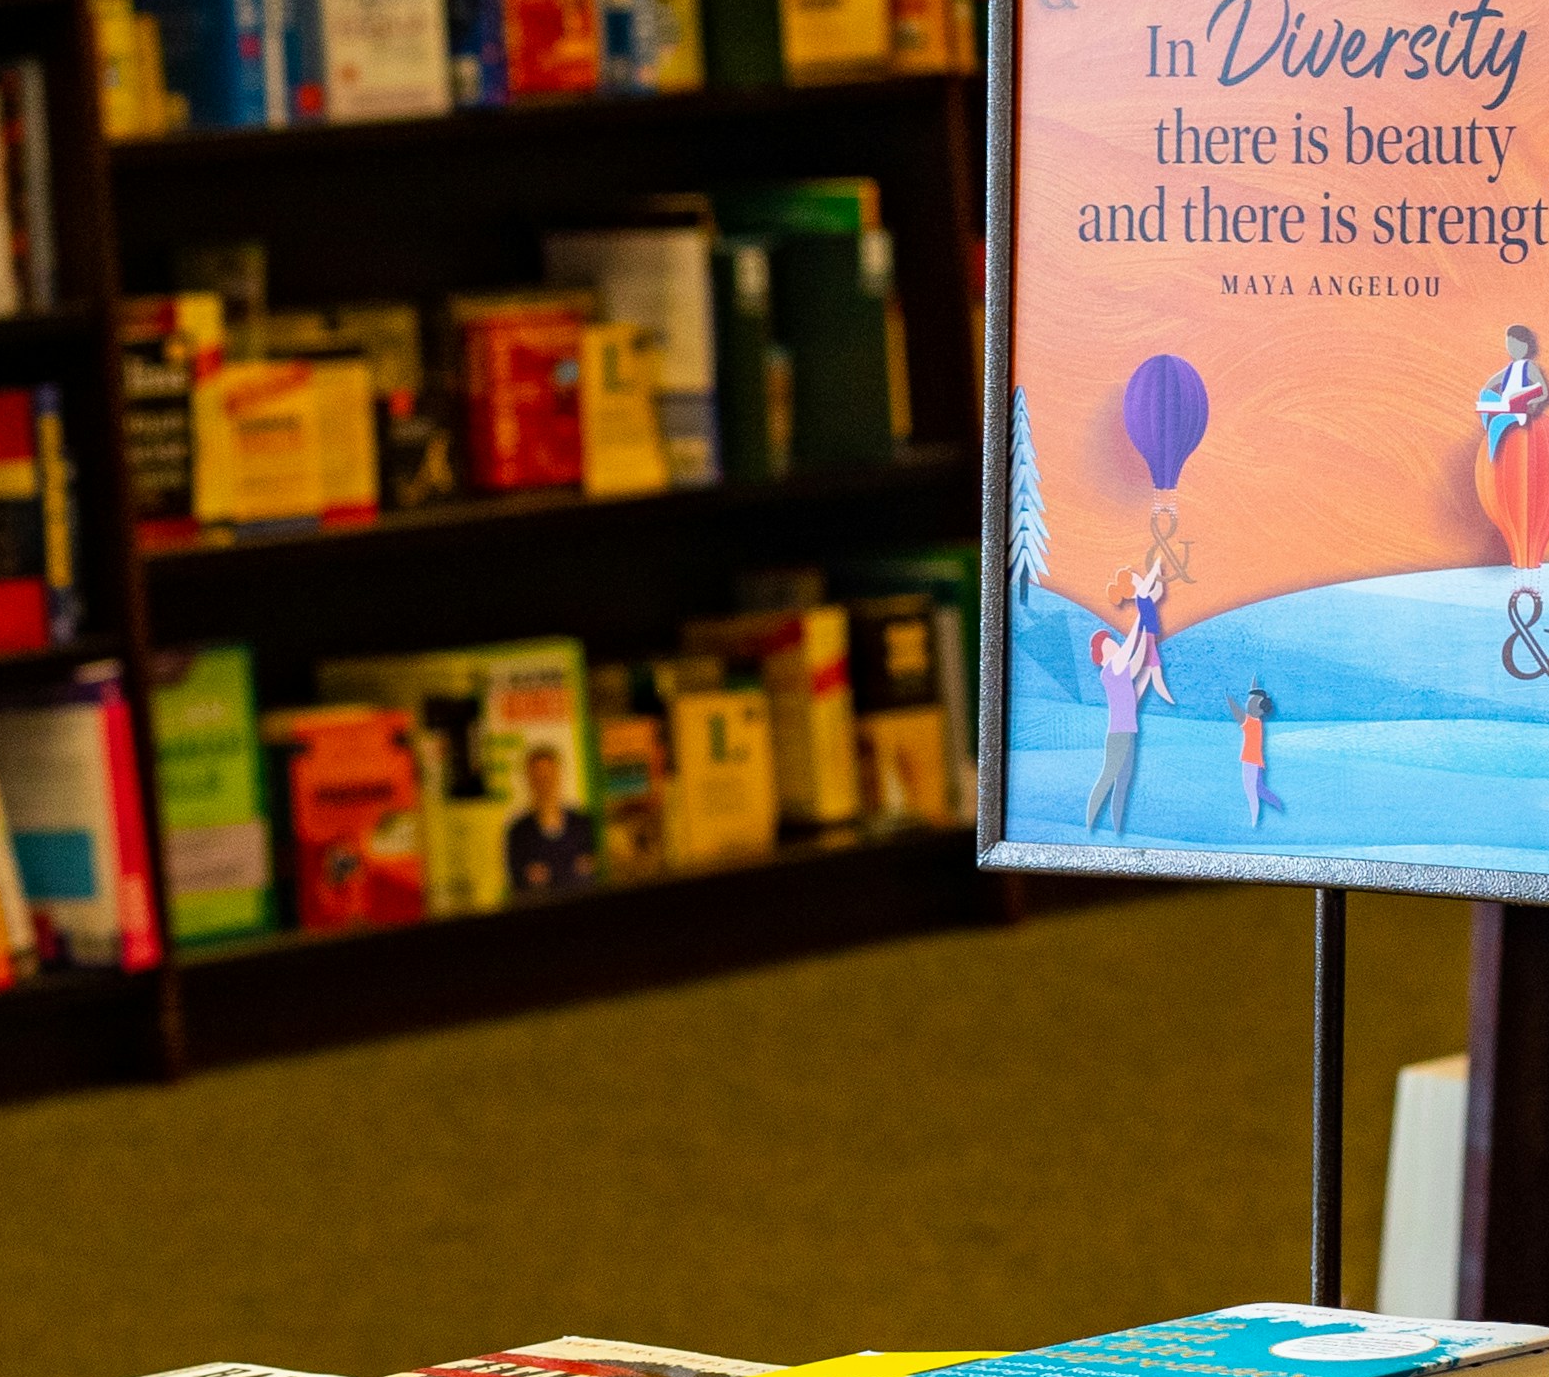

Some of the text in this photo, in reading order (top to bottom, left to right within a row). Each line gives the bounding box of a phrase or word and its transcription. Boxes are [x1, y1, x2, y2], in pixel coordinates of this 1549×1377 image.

[1145, 25, 1195, 79] In
[1154, 106, 1518, 183] there is beauty
[1078, 185, 1166, 244] and
[1180, 187, 1306, 245] there
[1320, 191, 1357, 246] is
[1220, 274, 1442, 298] MAYA ANGELOU
